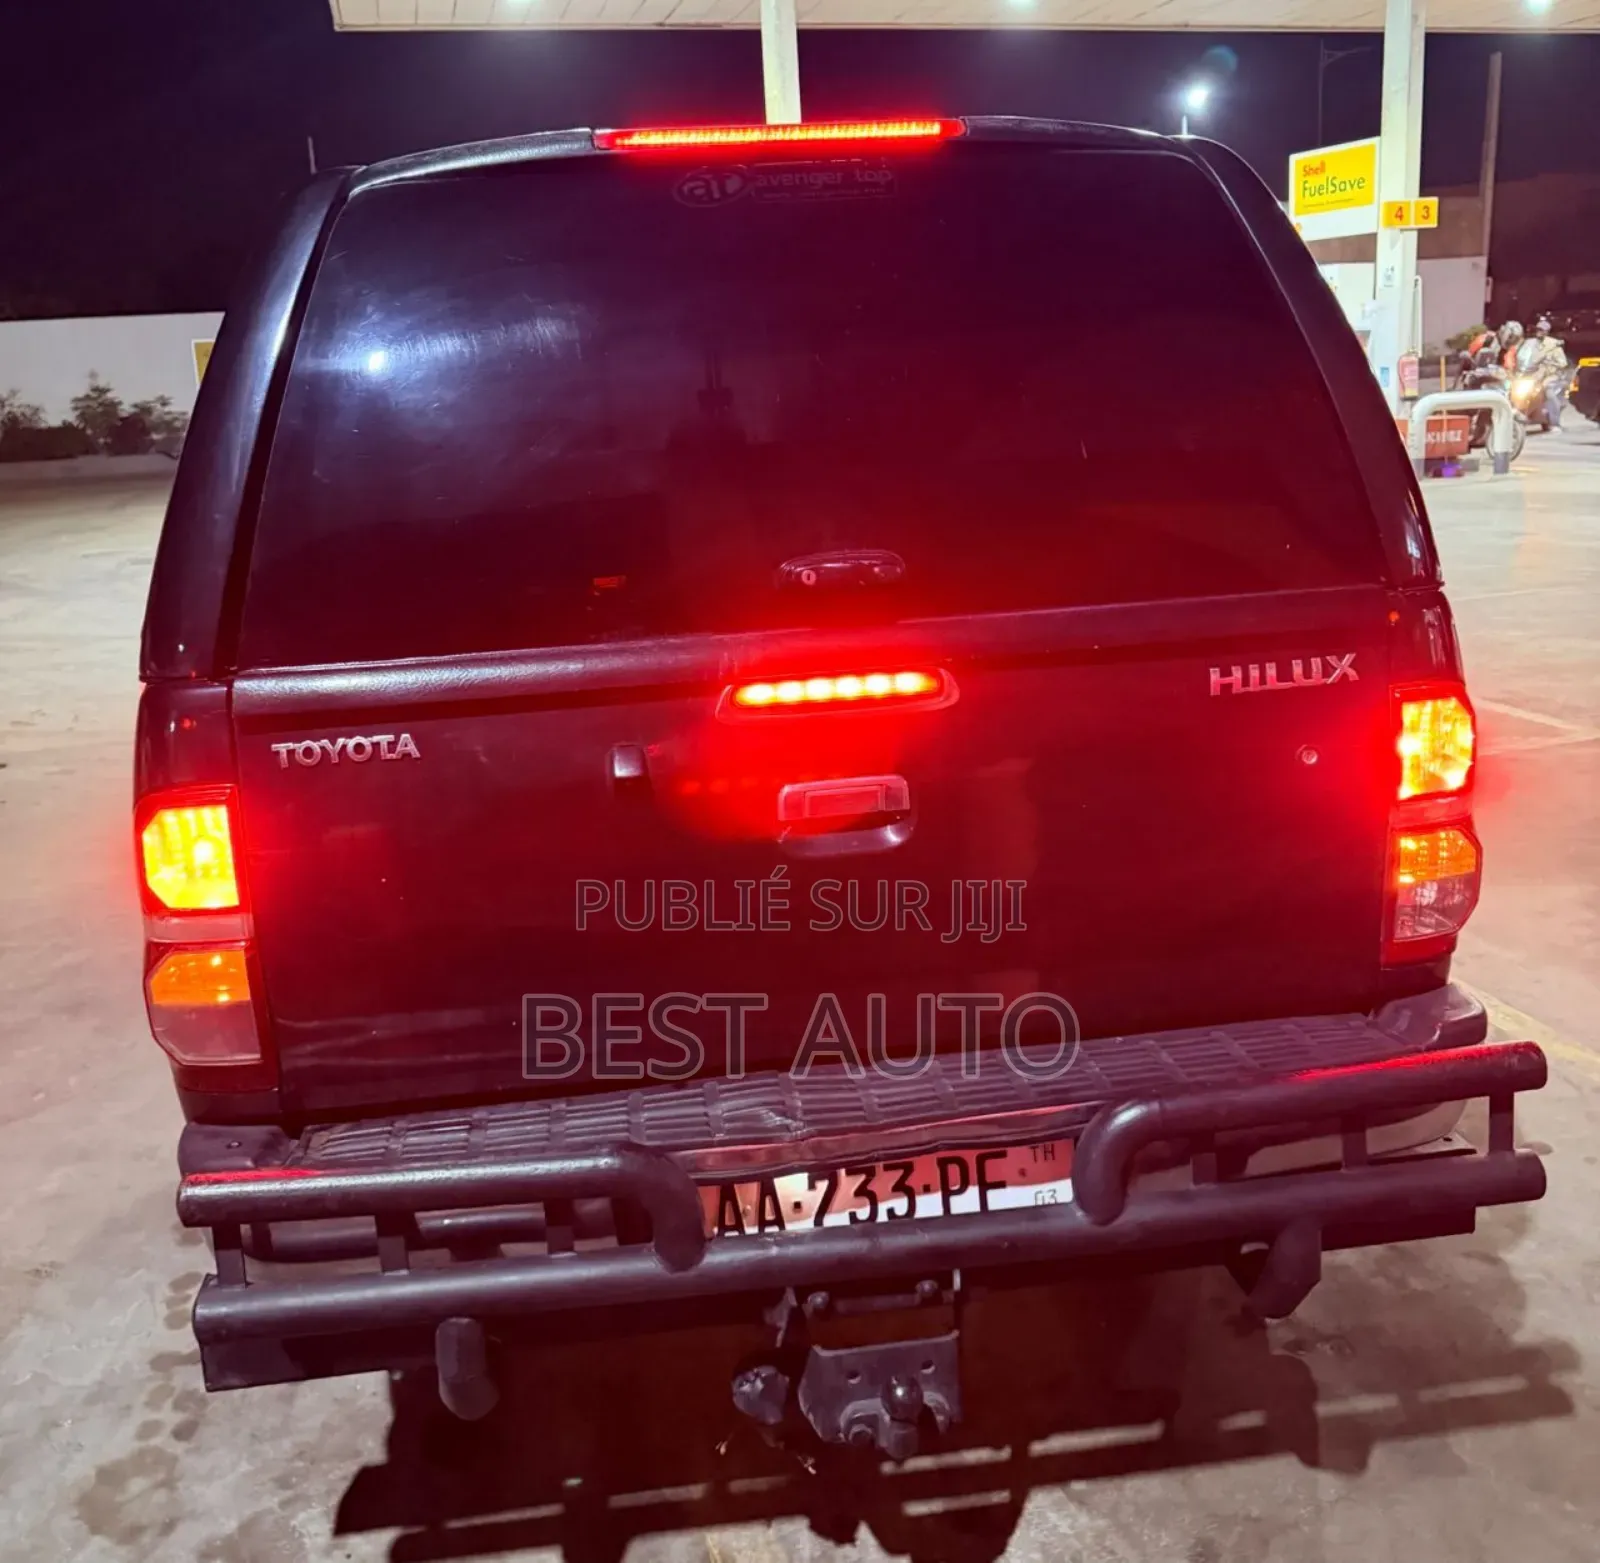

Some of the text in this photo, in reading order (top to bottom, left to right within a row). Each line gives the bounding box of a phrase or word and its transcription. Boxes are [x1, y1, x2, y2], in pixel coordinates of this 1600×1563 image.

[756, 167, 893, 189] avenger top
[1302, 160, 1326, 177] Shell
[1302, 175, 1366, 198] FuelSave
[1394, 205, 1431, 222] 4 3
[1209, 652, 1360, 697] HILUX
[271, 733, 421, 769] TOYOTA
[1029, 1143, 1056, 1164] TH
